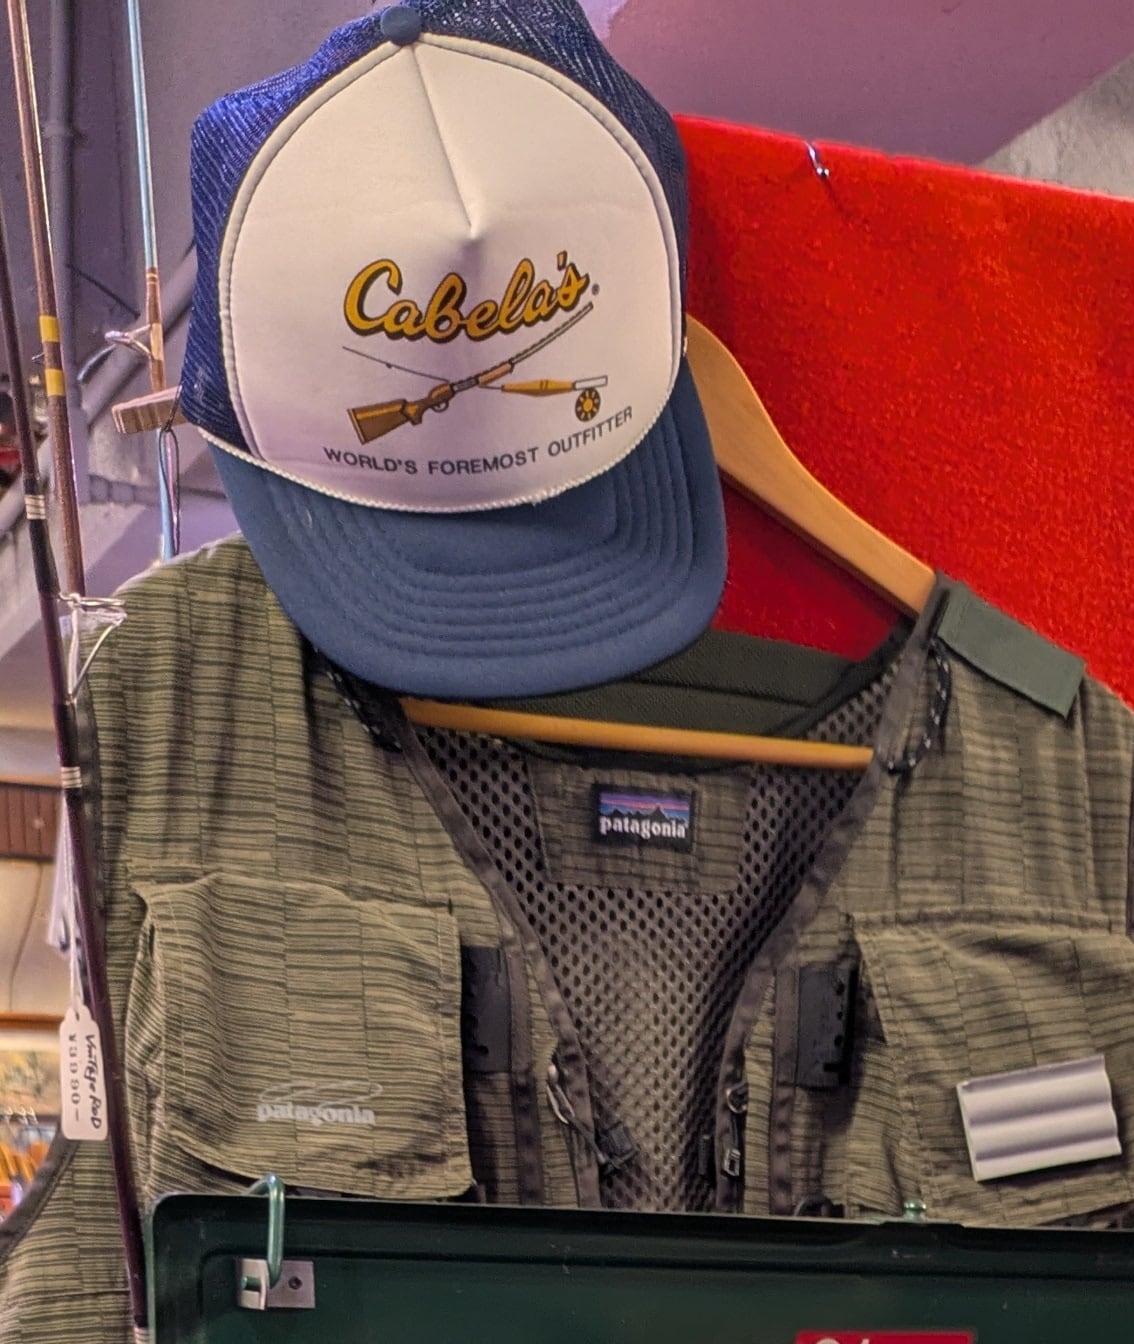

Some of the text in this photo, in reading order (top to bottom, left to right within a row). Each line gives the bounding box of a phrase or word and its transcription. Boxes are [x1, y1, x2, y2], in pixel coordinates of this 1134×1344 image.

[343, 249, 591, 344] Cabela's
[323, 405, 633, 476] WORLD'S FOREMOST OUTFITTER
[600, 815, 687, 840] patagonia
[256, 1101, 376, 1126] patagonia
